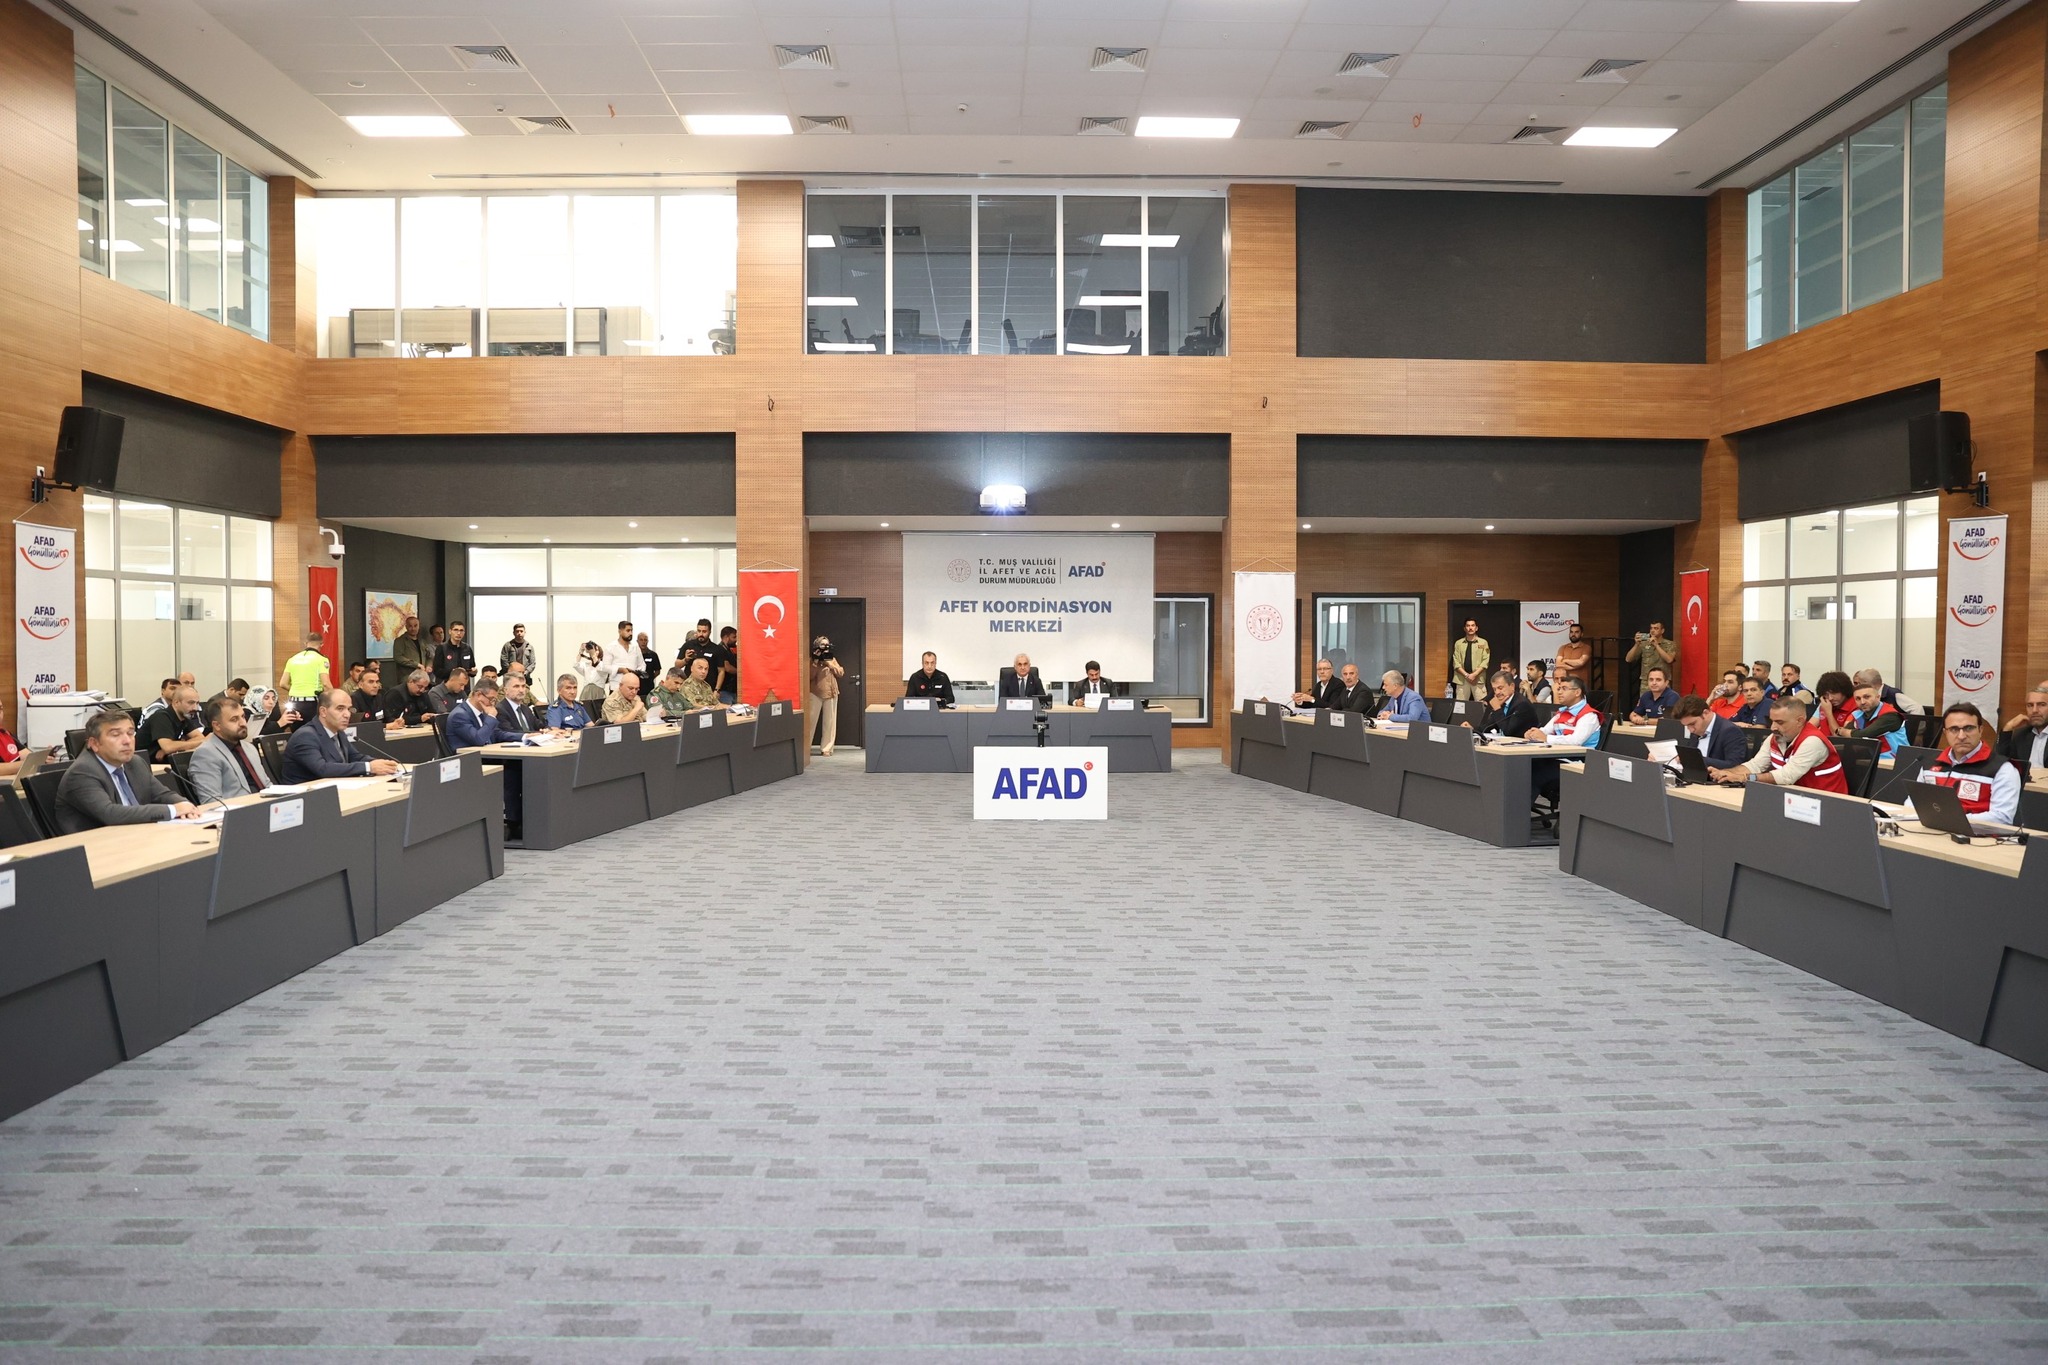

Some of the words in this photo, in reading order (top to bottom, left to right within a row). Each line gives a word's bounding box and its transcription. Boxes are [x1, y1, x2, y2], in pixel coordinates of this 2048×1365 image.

[1965, 528, 1985, 538] AFAD
[34, 536, 55, 547] AFAD
[27, 546, 60, 559] Gönüllüsü
[979, 558, 994, 566] T.C.
[999, 558, 1017, 567] MUŞ
[1022, 557, 1056, 566] VALİLİĞİ
[979, 567, 987, 575] İL
[1035, 567, 1057, 575] ACİL
[1068, 565, 1104, 577] AFAD
[1008, 576, 1056, 584] MÜDÜRLÜĞÜ
[1963, 594, 1983, 604] AFAD
[939, 600, 978, 613] AFET
[983, 597, 1112, 613] KOORDİNASYON
[34, 606, 55, 616] AFAD
[28, 616, 60, 628] Gönüllüsü
[989, 617, 1062, 633] MERKEZİ
[1960, 659, 1981, 669] AFAD
[34, 674, 56, 684] AFAD
[992, 767, 1088, 799] AFAD
